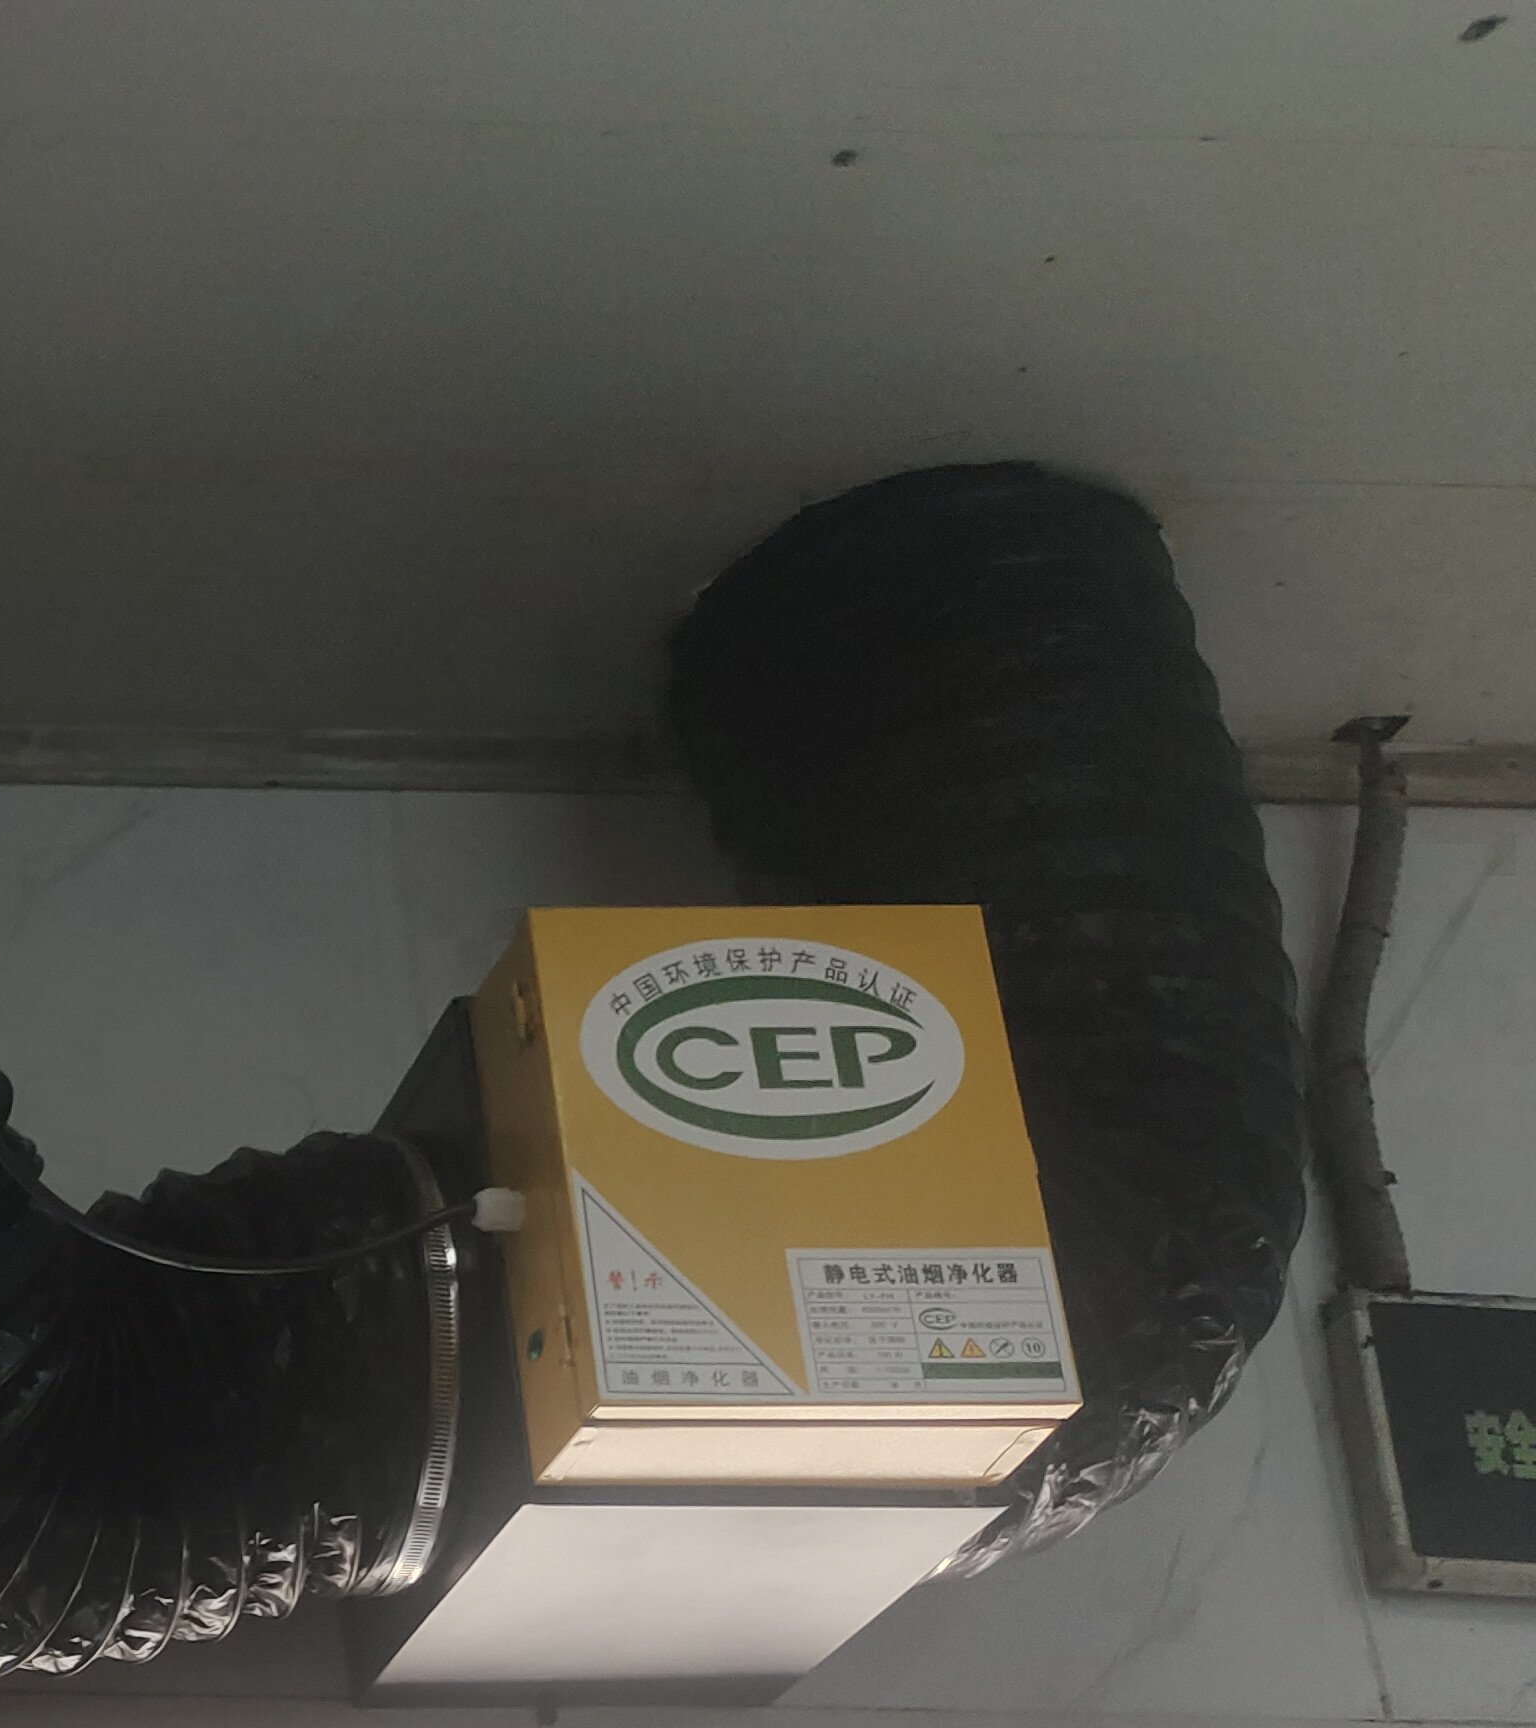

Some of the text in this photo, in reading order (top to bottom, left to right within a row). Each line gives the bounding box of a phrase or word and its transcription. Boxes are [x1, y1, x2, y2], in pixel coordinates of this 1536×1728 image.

[609, 947, 918, 1017] 中国环境保护产品认证
[655, 1025, 918, 1091] CEP
[823, 1262, 1019, 1286] 静电式油烟净化器
[621, 1369, 759, 1388] 油烟净化器
